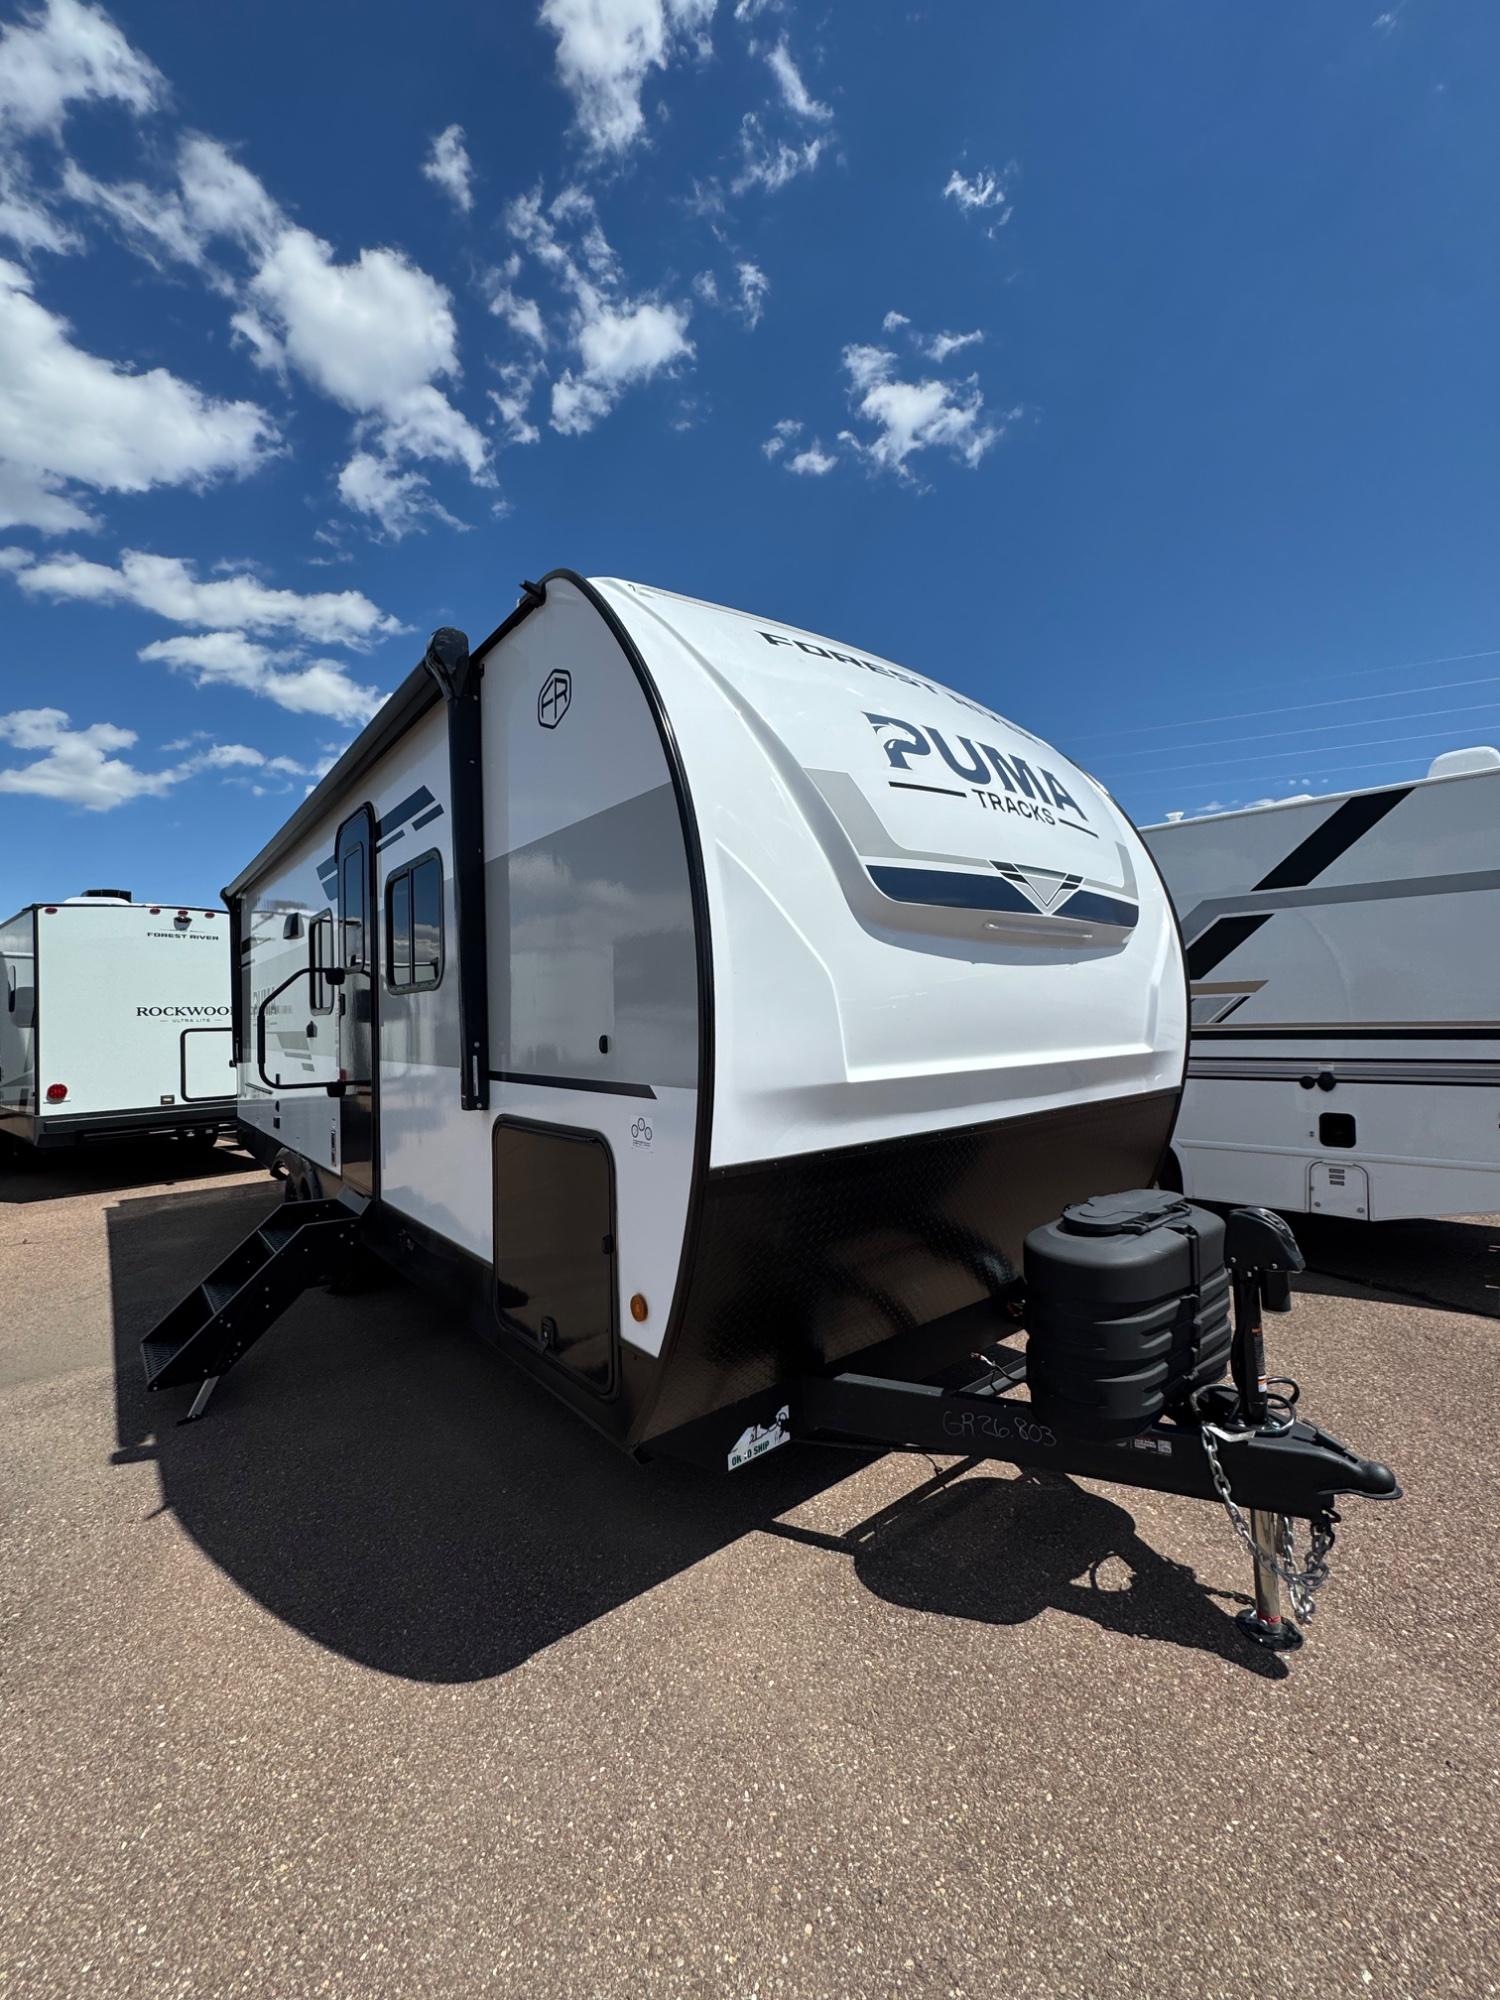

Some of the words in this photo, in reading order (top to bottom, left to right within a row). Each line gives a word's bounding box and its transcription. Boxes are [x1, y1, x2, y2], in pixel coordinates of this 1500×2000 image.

[754, 630, 938, 694] FOREST
[860, 710, 1089, 823] PUMA
[970, 787, 1057, 826] TRACKS
[147, 932, 188, 940] FOREST
[136, 1006, 233, 1017] ROCKWOO
[731, 1455, 742, 1467] OK
[753, 1440, 770, 1456] SHIP
